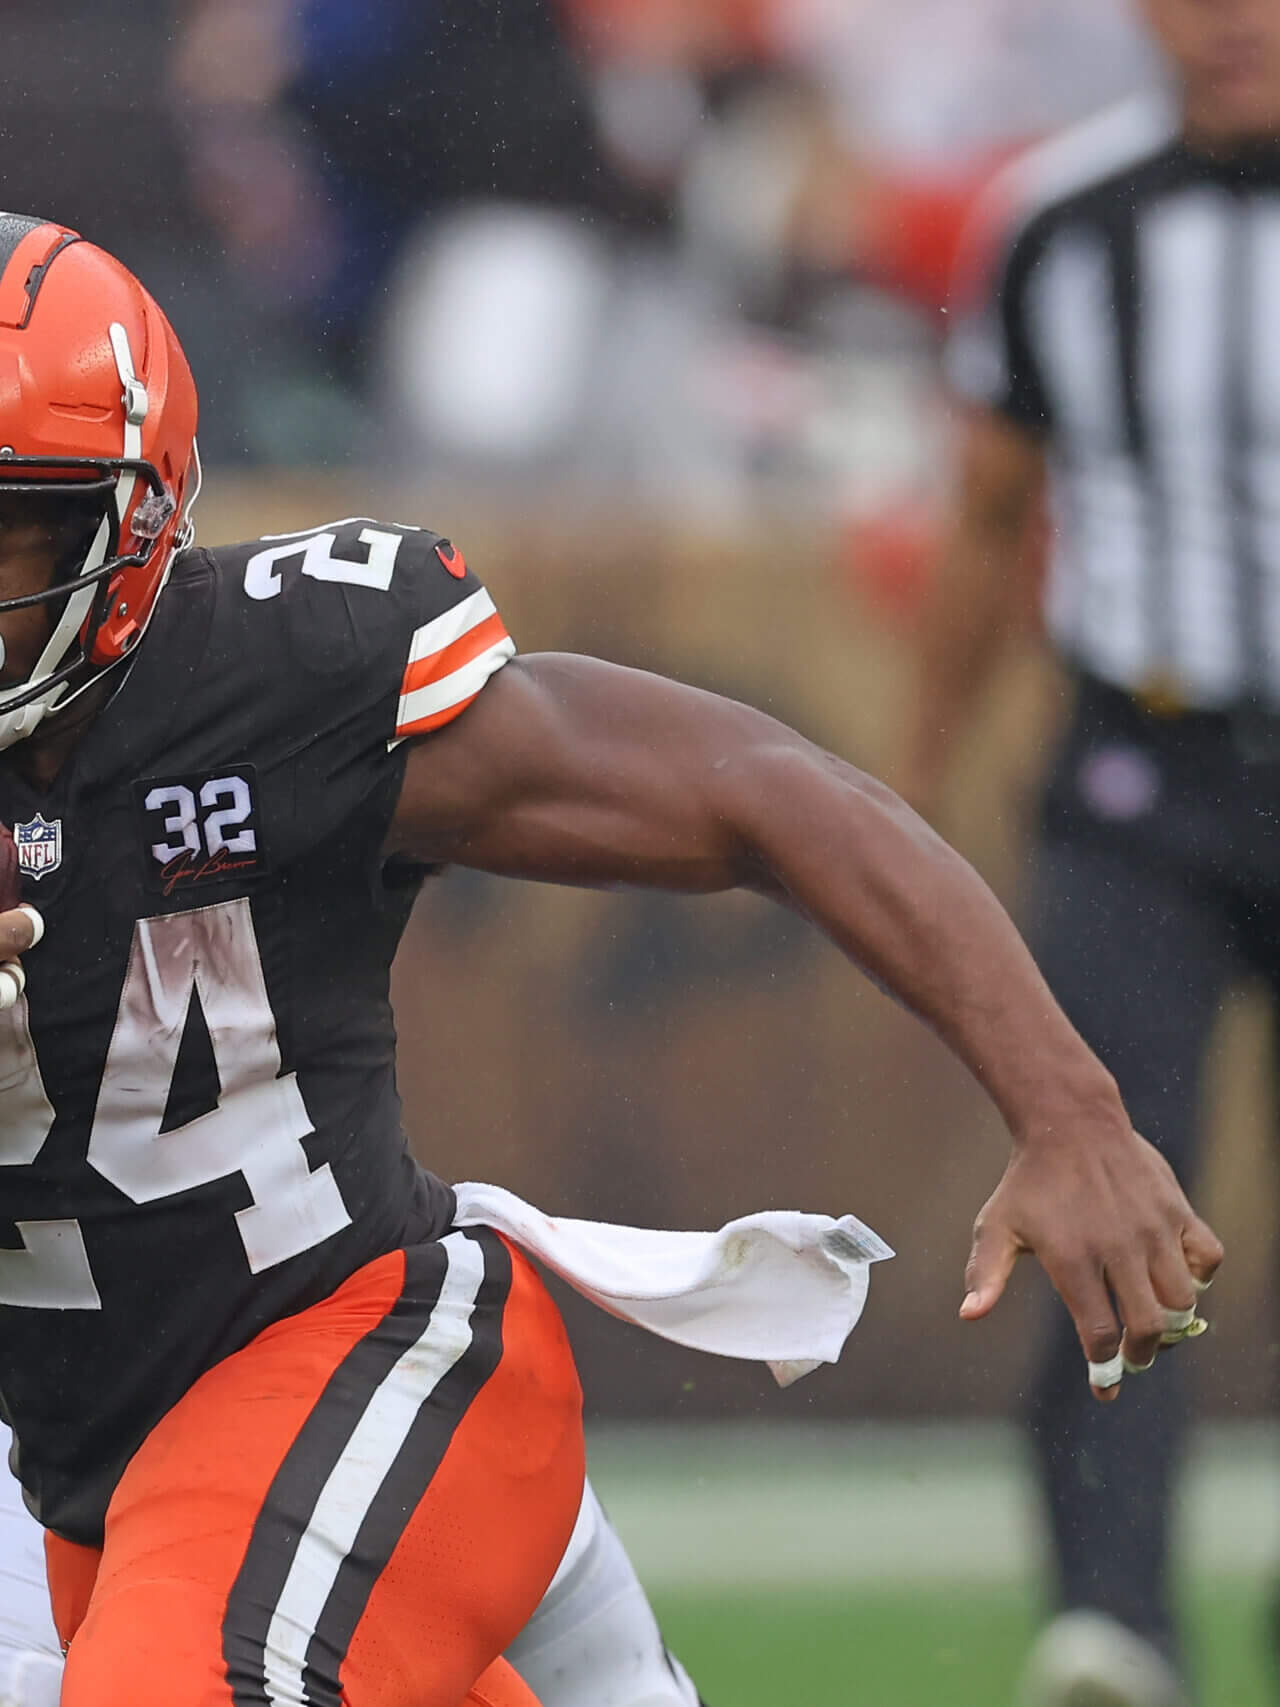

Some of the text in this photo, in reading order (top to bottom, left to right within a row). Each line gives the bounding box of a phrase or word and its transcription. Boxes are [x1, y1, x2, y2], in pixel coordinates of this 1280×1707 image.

[243, 517, 421, 600] 2
[21, 843, 54, 868] NFL
[145, 776, 257, 865] 32
